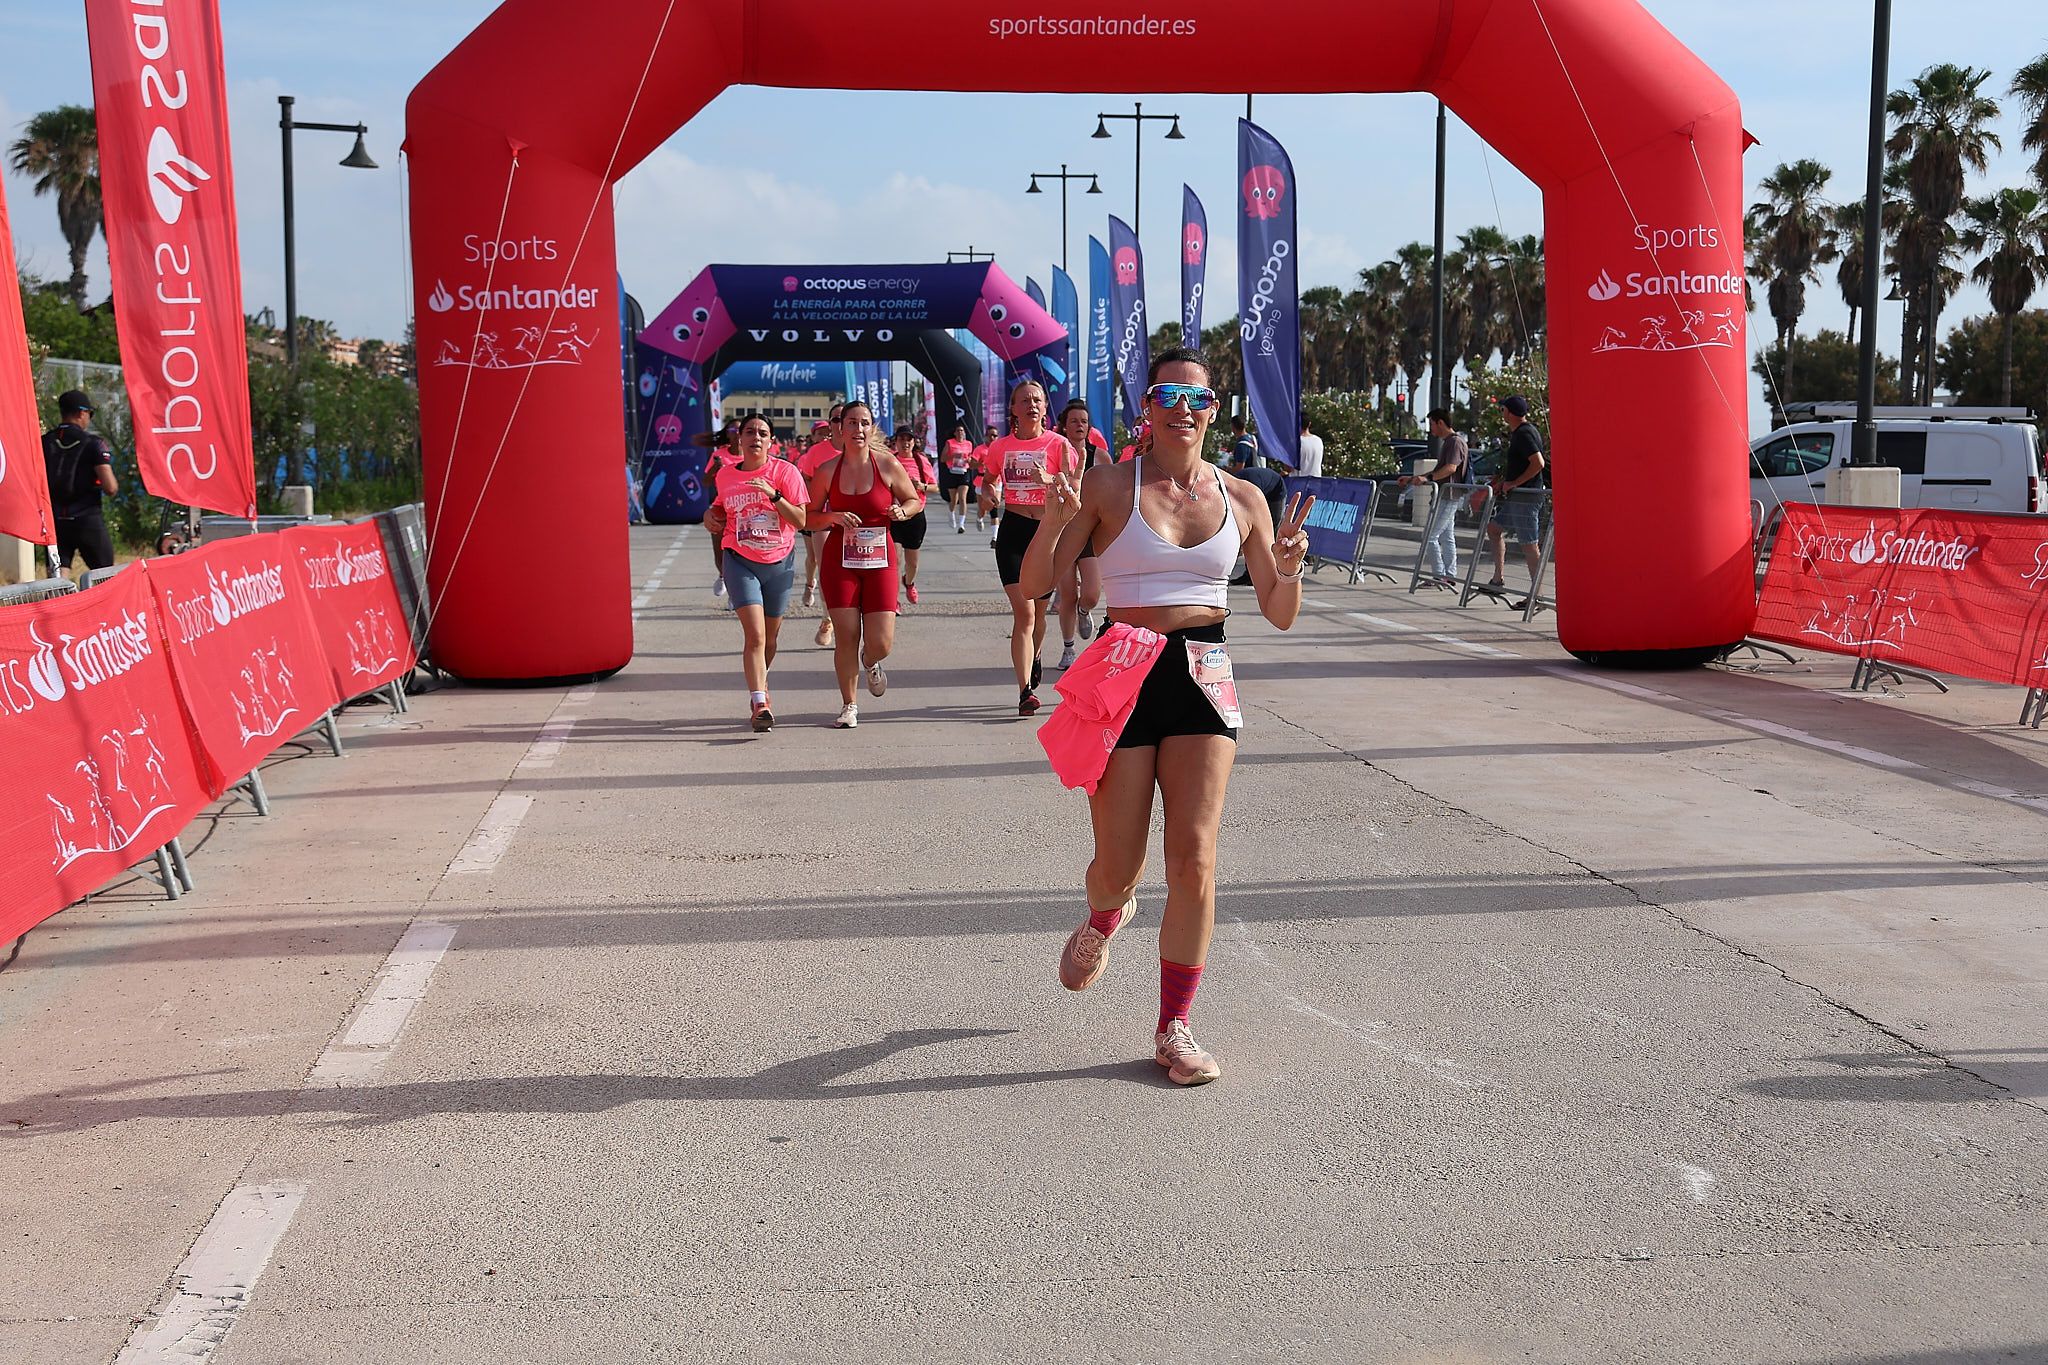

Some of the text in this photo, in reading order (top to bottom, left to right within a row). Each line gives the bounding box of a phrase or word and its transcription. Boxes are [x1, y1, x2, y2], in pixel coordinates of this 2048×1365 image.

[989, 14, 1196, 39] sportssantander.es
[463, 234, 558, 269] Sports
[1633, 223, 1718, 256] Sports
[1626, 270, 1743, 297] Santander
[458, 283, 599, 311] Santander
[773, 297, 926, 309] LA ENERGÍA PARA CORRER
[772, 311, 929, 320] A LA VELOCIDAD DE LA LUZ
[748, 329, 894, 342] VOLVO
[760, 363, 817, 387] Marlene
[725, 491, 763, 510] CARRERA
[857, 546, 875, 554] 016
[1793, 524, 1852, 564] Sports
[1874, 529, 1979, 571] Santander
[167, 588, 215, 657] Sports
[220, 559, 286, 619] Santander
[1102, 639, 1158, 669] UJE
